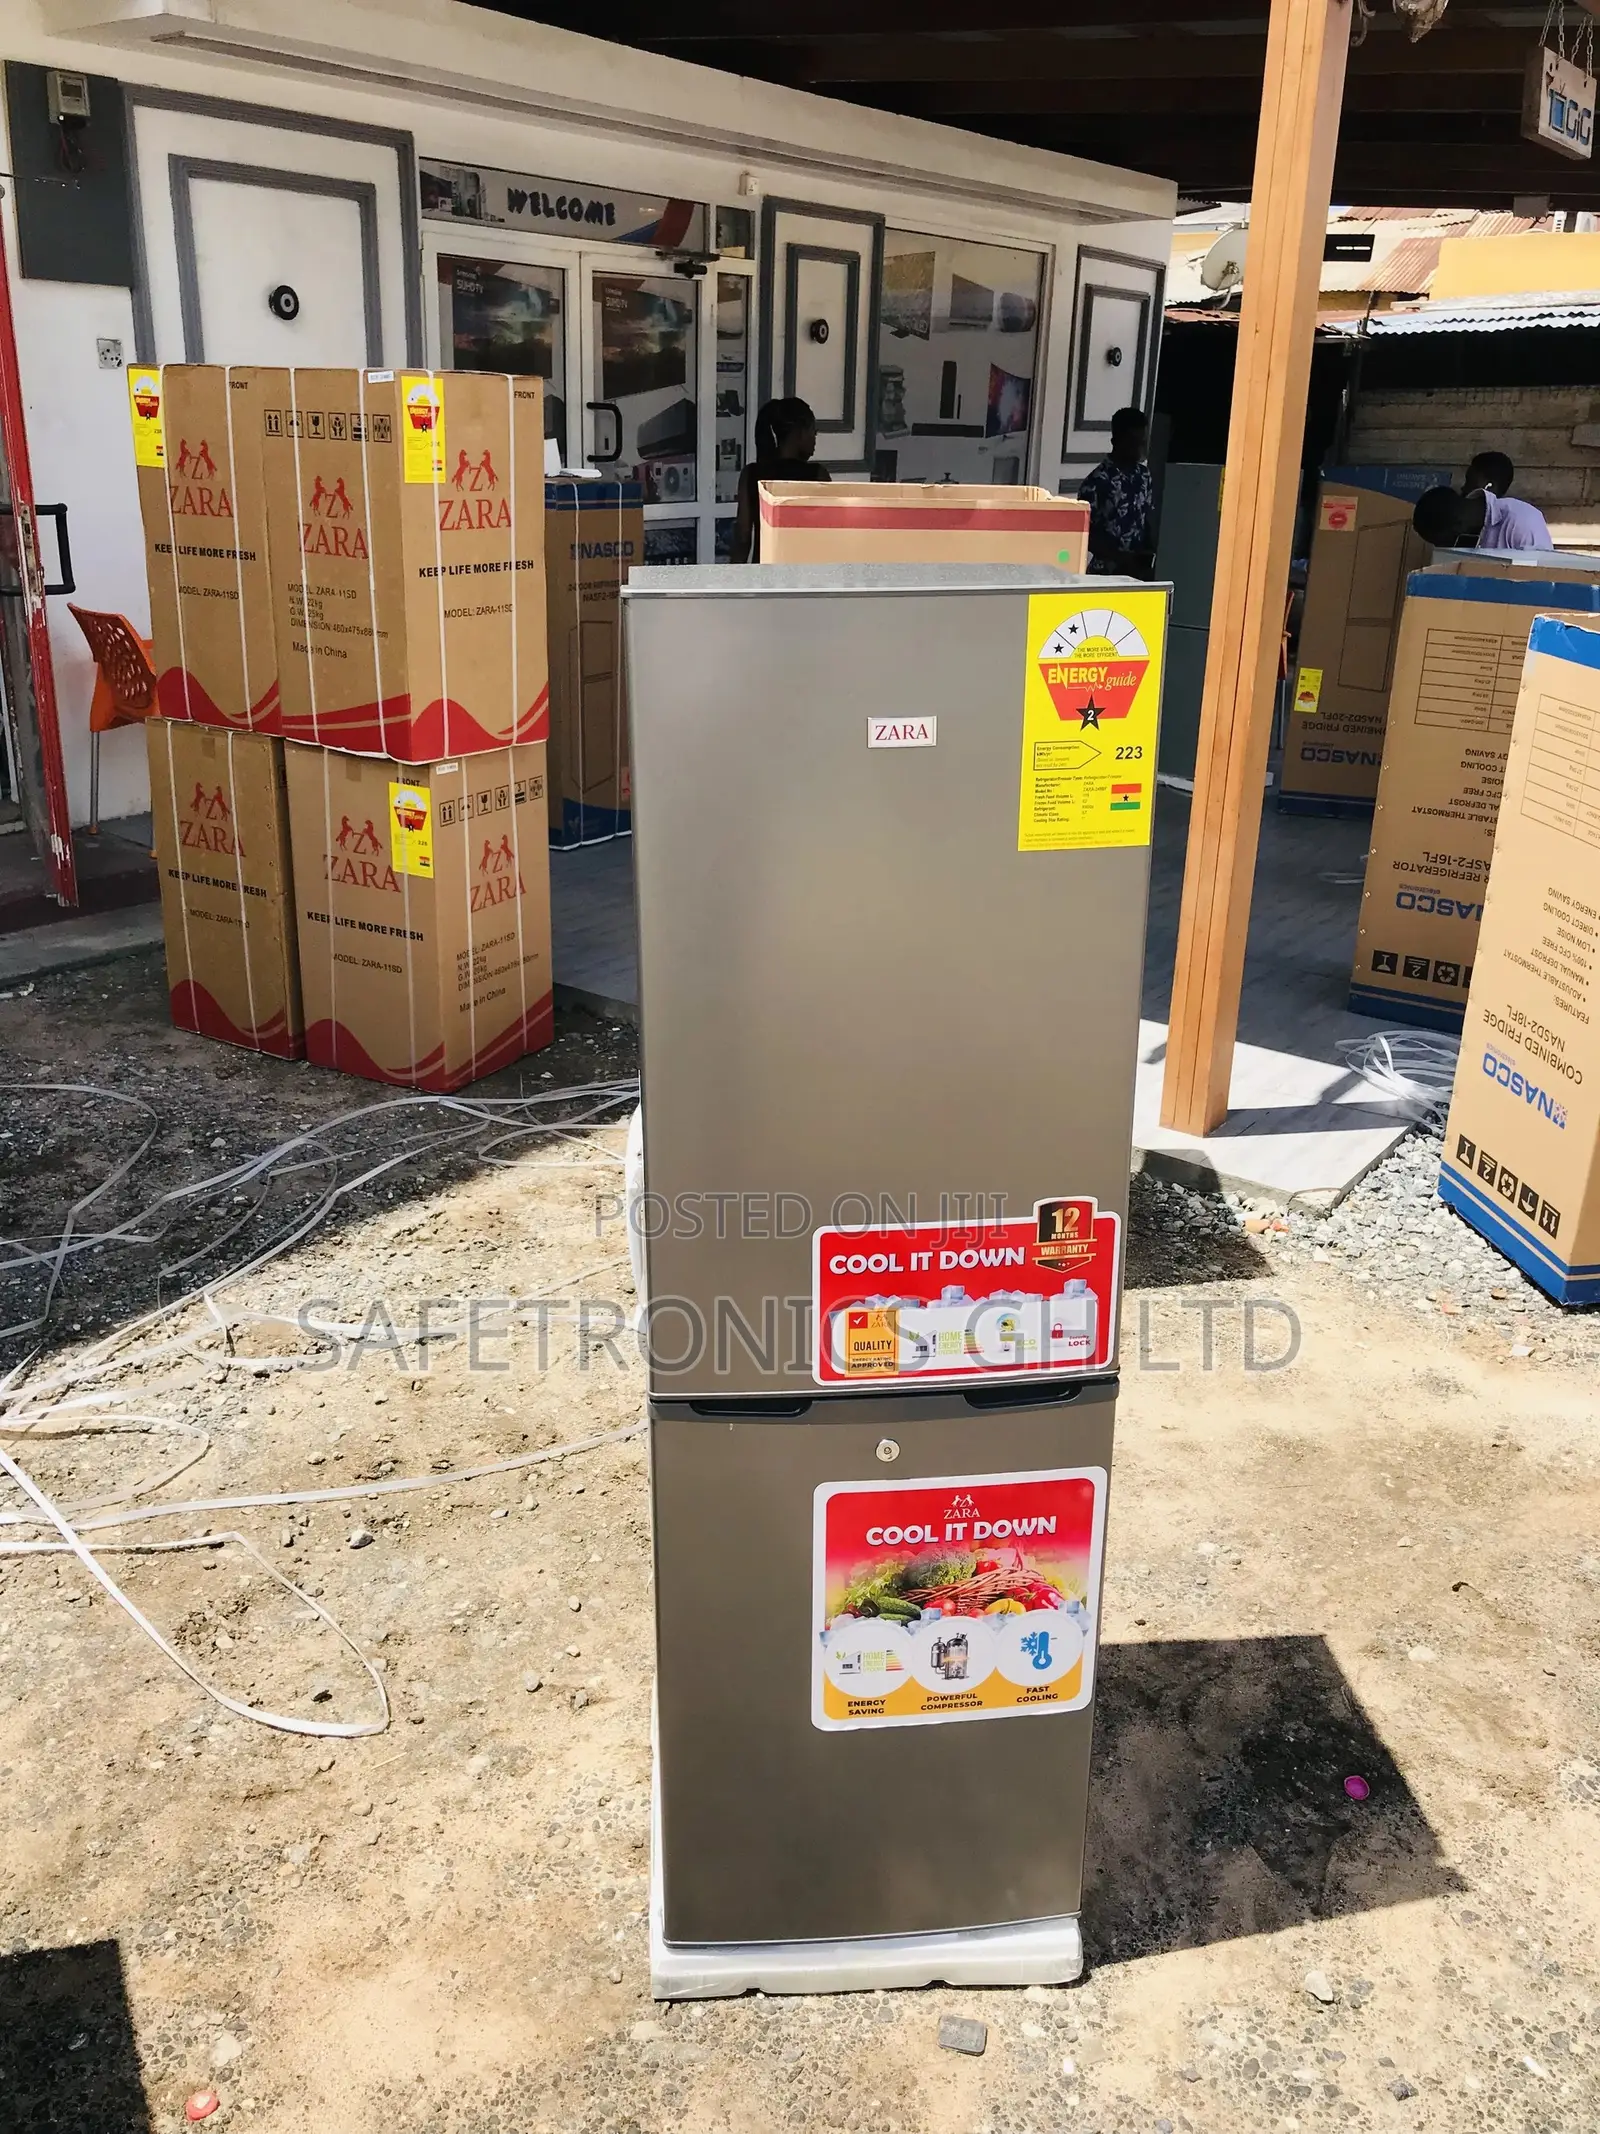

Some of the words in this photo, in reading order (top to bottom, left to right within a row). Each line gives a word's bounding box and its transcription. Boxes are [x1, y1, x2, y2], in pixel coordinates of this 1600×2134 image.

[507, 187, 616, 226] WELCOME
[514, 390, 535, 399] FRONT
[169, 486, 234, 518] ZARA
[438, 498, 513, 531] ZARA
[298, 521, 370, 560] ZARA
[178, 545, 198, 557] LIFE
[199, 546, 225, 559] MORE
[580, 541, 634, 559] NASCO
[448, 563, 472, 576] LIFE
[473, 561, 501, 574] MORE
[444, 606, 476, 619] MODEL:
[323, 645, 348, 659] China
[1048, 664, 1107, 688] ENERGY
[1106, 674, 1137, 691] guide
[1087, 710, 1095, 721] 2
[874, 723, 929, 741] ZARA
[1301, 721, 1340, 732] FRIDGE
[1115, 746, 1143, 760] 223
[1301, 747, 1377, 766] NASCO
[1465, 748, 1496, 759] SAVING
[1460, 760, 1498, 772] COOLING
[1463, 786, 1485, 797] FREE
[1448, 798, 1486, 810] DEFROST
[1411, 805, 1466, 820] THERMOSTAT
[180, 820, 247, 858] ZARA
[322, 854, 402, 894] ZARA
[1392, 860, 1481, 882] REFRIGERATOR
[191, 872, 210, 887] LIFE
[211, 877, 237, 891] MORE
[470, 873, 527, 913] ZARA
[1547, 887, 1571, 906] SAVING
[1543, 902, 1571, 923] COOLING
[1571, 899, 1597, 919] ENERGY
[334, 916, 357, 930] LIFE
[358, 921, 388, 935] MORE
[1571, 916, 1594, 936] DIRECT
[1556, 926, 1576, 944] NOISE
[1541, 936, 1558, 952] FREE
[1558, 945, 1572, 959] CFC
[1575, 937, 1591, 953] LOW
[361, 958, 402, 974] ZARA-11SD
[1503, 948, 1542, 977] THERMOSTAT
[1530, 947, 1558, 969] DEFROST
[1572, 953, 1588, 968] 100%
[1558, 961, 1585, 984] MANUAL
[1542, 969, 1583, 1001] ADJUSTABLE
[486, 987, 506, 1001] China
[1553, 994, 1590, 1025] FEATURES:
[1482, 1008, 1523, 1044] FRIDGE
[1506, 1004, 1566, 1052] NASD2-18FL
[1524, 1037, 1583, 1085] COMBINED
[1482, 1052, 1555, 1120] NASCO
[1051, 1207, 1081, 1233] 12
[1050, 1232, 1079, 1240] MONTHS
[1041, 1243, 1089, 1256] WARRANTY
[829, 1254, 904, 1275] COOL
[910, 1251, 933, 1272] IT
[939, 1247, 1025, 1270] DOWN
[938, 1331, 962, 1342] HOME
[1068, 1339, 1091, 1347] LOCK
[853, 1340, 892, 1352] QUALITY
[851, 1361, 894, 1369] APPROVED
[943, 1508, 981, 1520] ZARA
[866, 1525, 938, 1546] COOL
[945, 1522, 968, 1542] IT
[973, 1516, 1057, 1540] DOWN
[926, 1693, 978, 1702] POWERFUL
[1026, 1685, 1050, 1694] FAST
[847, 1699, 886, 1708] ENERGY
[920, 1700, 983, 1711] COMPRESSOR
[1016, 1693, 1058, 1704] COOLING
[848, 1707, 885, 1716] SAVING
